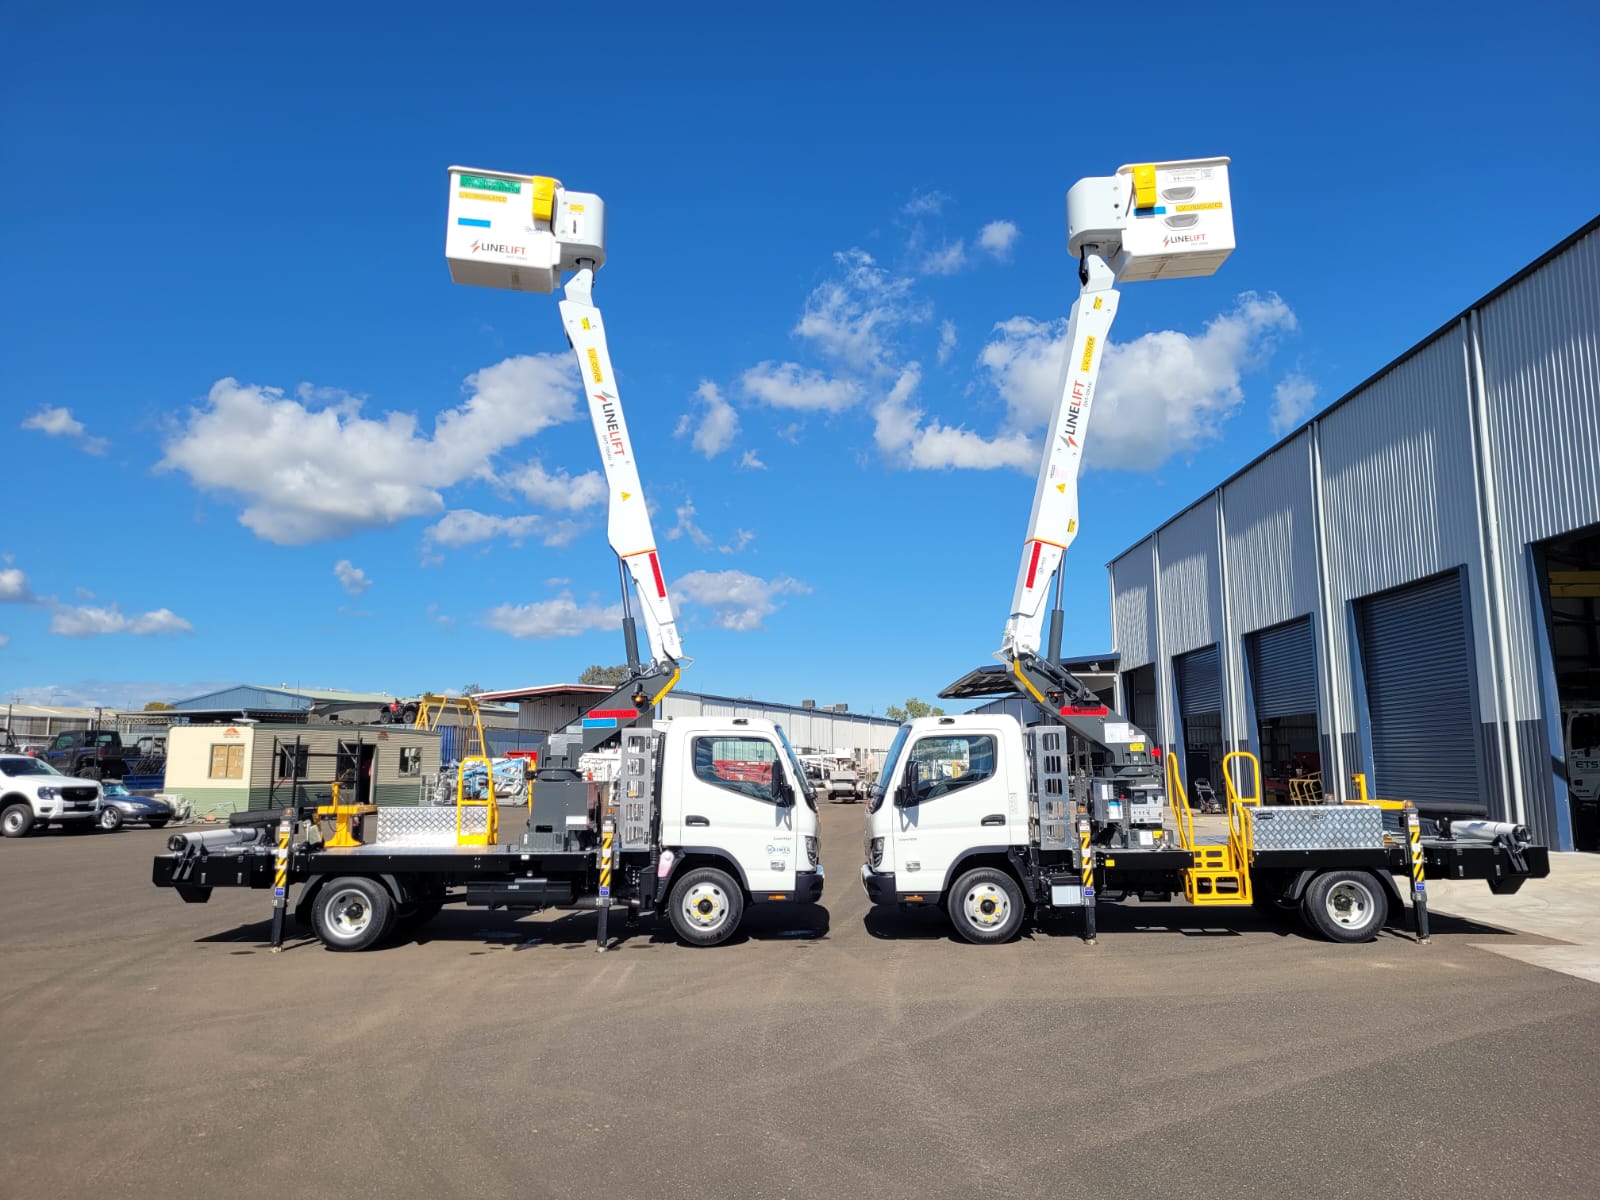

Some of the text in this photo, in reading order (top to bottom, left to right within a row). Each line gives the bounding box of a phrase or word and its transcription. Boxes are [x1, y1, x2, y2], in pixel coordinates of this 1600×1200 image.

[1171, 234, 1206, 244] LINELIFT
[481, 242, 527, 256] LINELIFT
[1065, 380, 1085, 435] LINELIFT
[602, 402, 625, 456] LINELIFT
[1576, 760, 1599, 769] ETS
